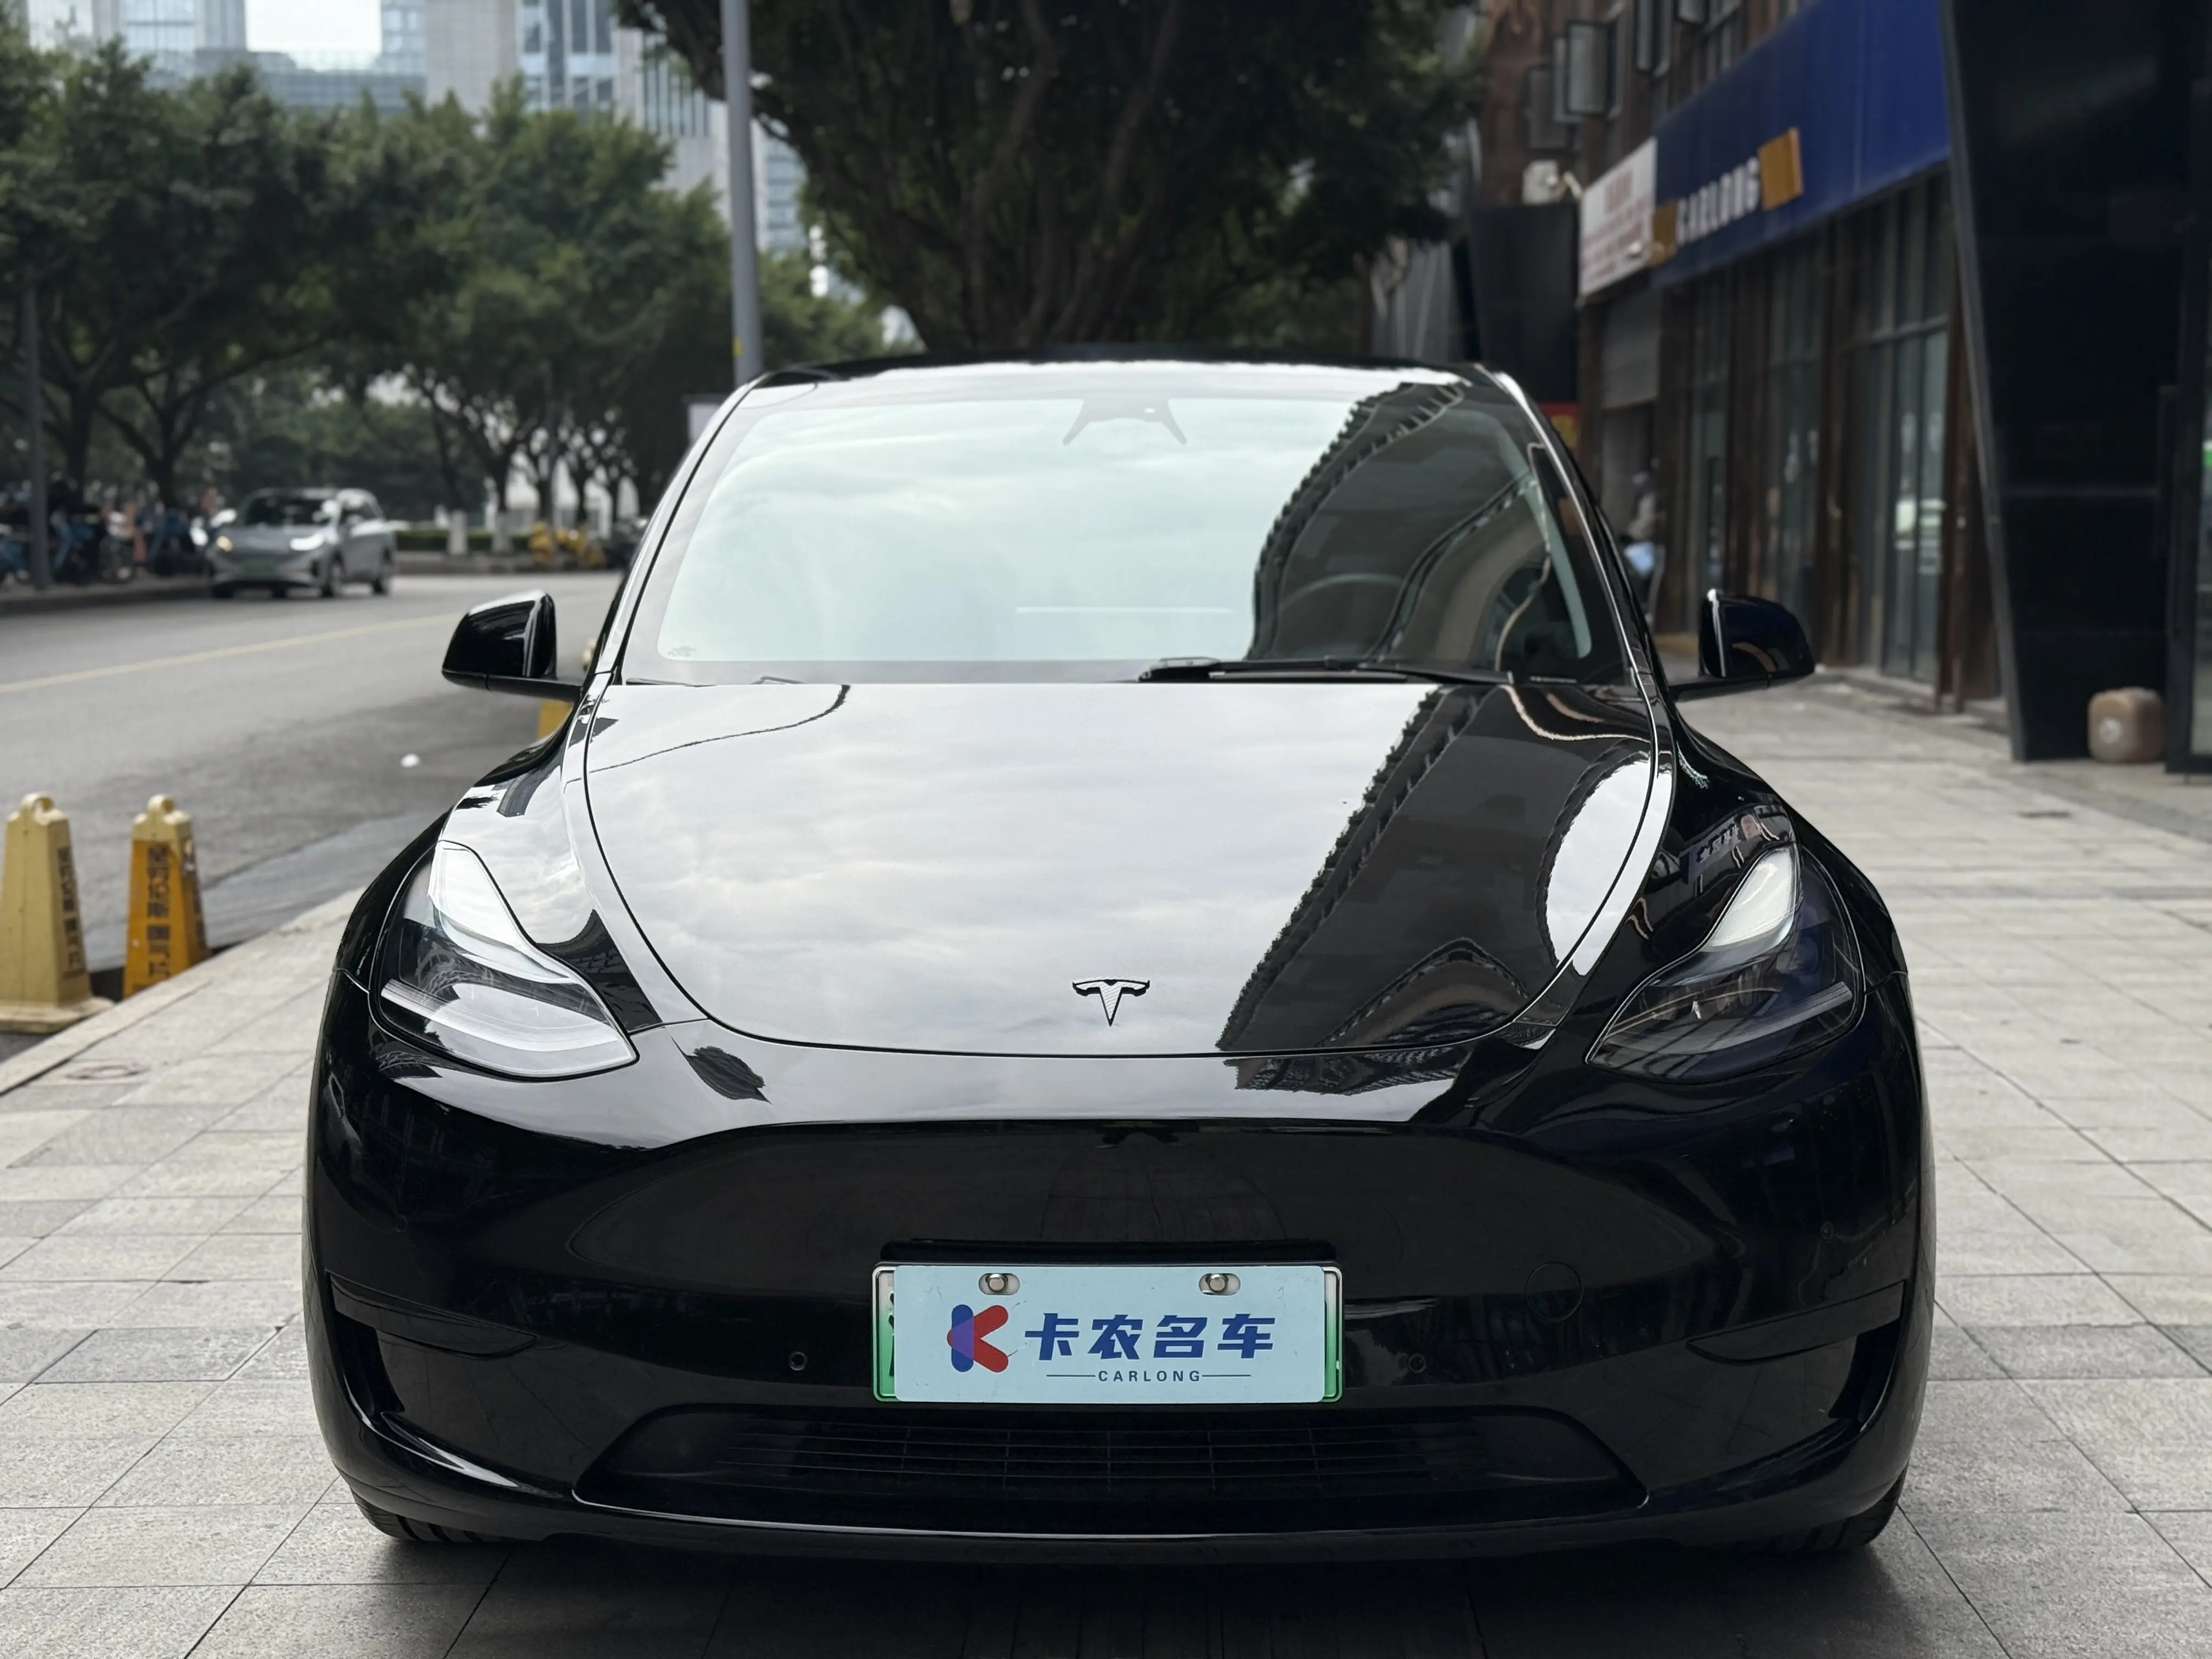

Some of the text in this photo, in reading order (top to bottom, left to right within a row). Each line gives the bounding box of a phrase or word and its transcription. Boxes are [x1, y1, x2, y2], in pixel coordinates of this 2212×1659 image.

[1024, 1313, 1276, 1361] 卡农名车
[1098, 1370, 1200, 1382] CARLONG
